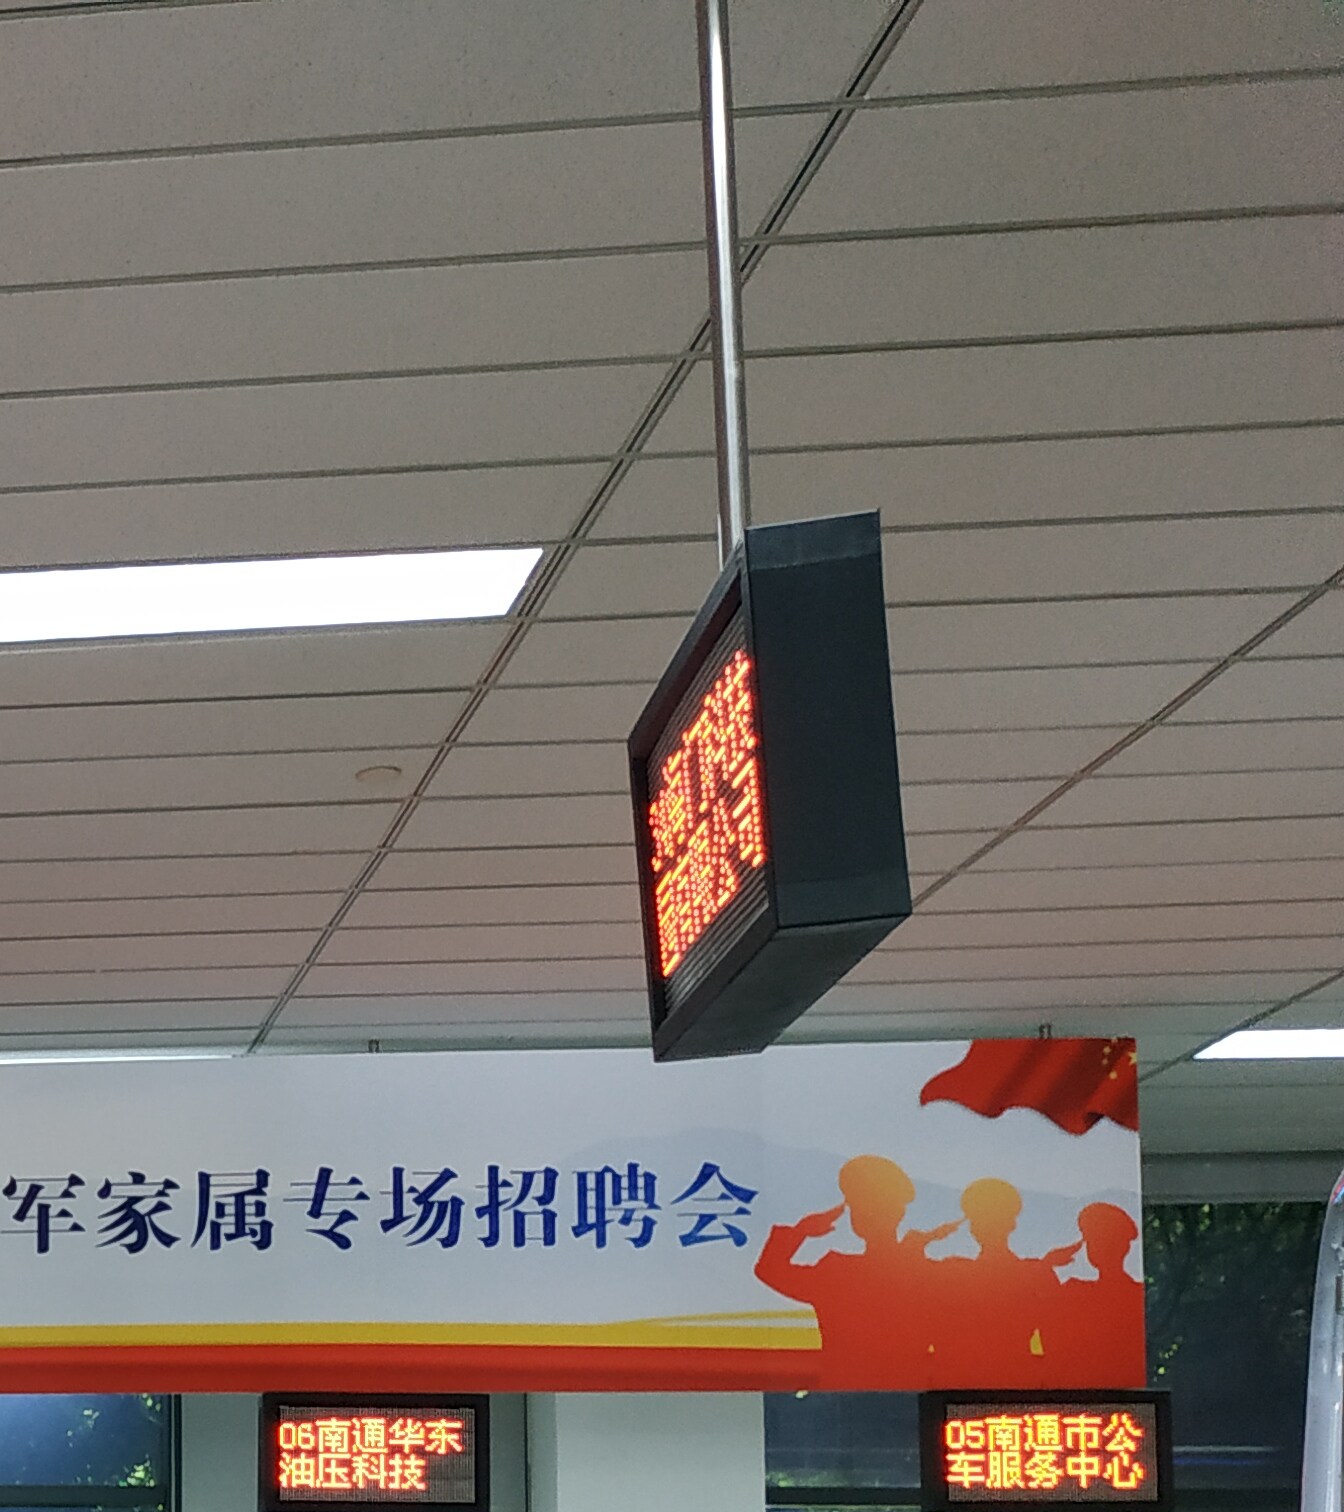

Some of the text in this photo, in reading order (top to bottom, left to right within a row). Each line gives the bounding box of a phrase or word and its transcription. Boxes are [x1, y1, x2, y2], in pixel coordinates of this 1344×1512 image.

[278, 1417, 464, 1454] 06南通华东
[945, 1413, 1144, 1451] 05南通市公
[278, 1452, 426, 1490] 油压科技
[945, 1451, 1144, 1489] 车服务中心
